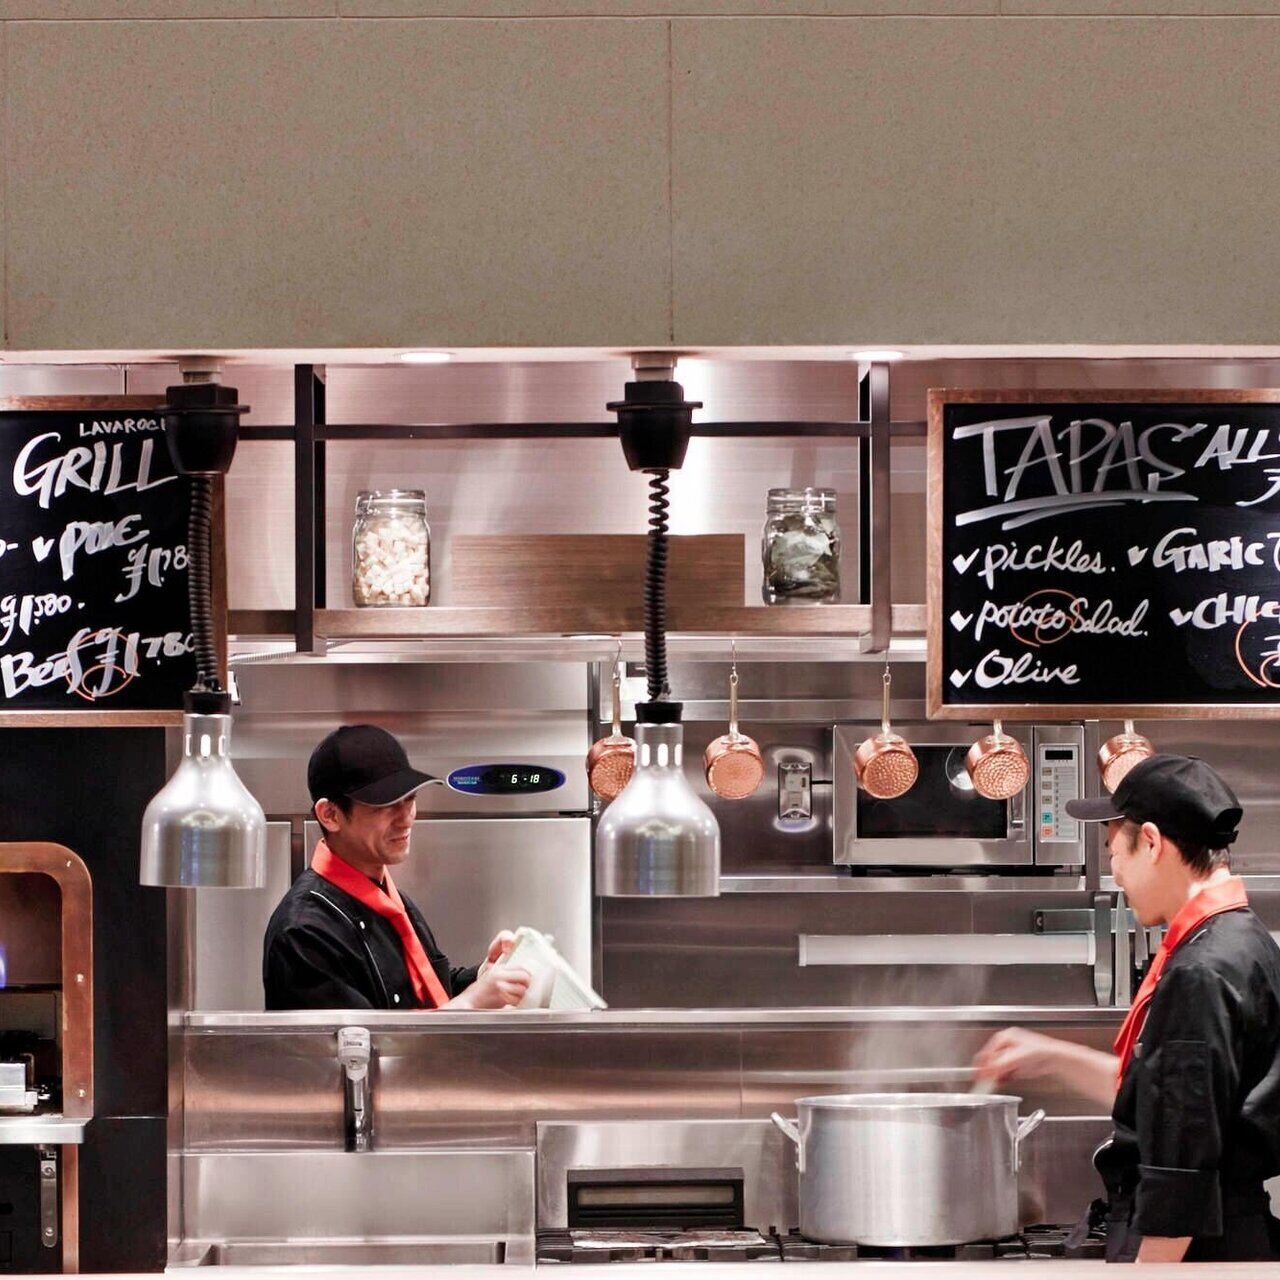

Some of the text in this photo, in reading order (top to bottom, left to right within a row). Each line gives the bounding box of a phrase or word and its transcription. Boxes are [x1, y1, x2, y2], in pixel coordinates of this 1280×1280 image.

[13, 432, 178, 509] GRILL
[952, 415, 1208, 503] TAPAS
[975, 600, 1066, 642] potato
[975, 649, 1082, 689] Olive
